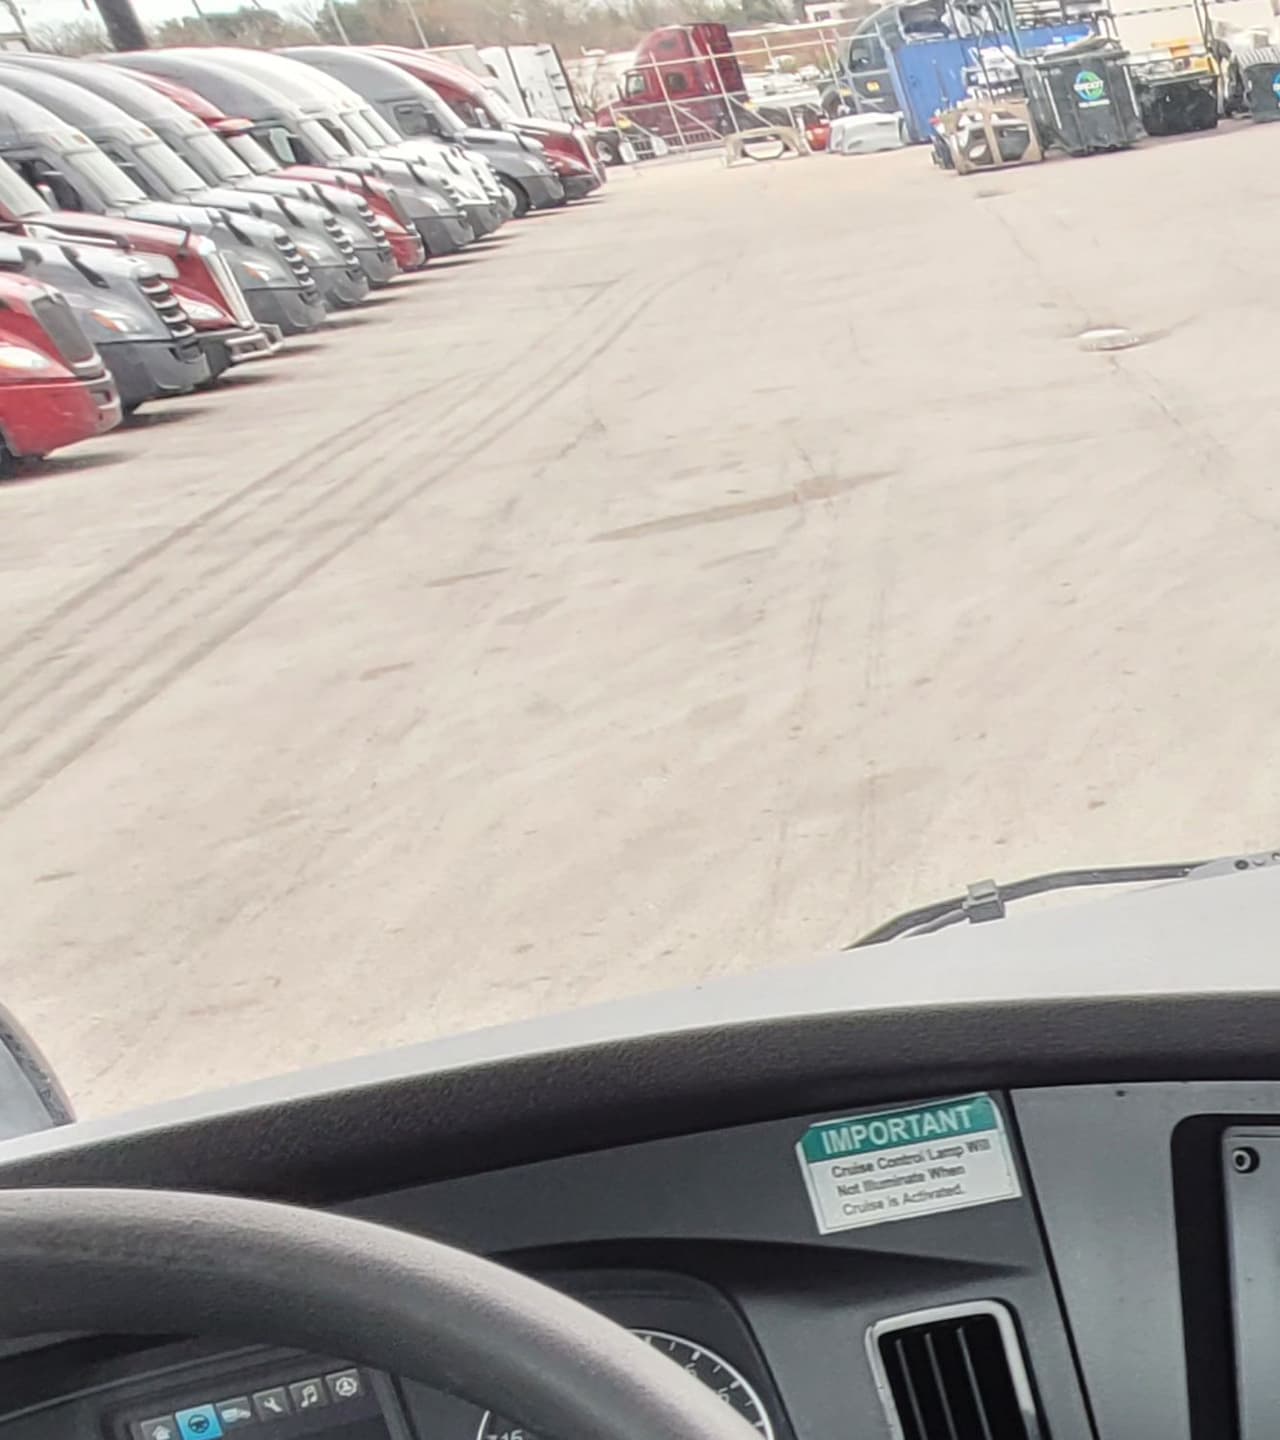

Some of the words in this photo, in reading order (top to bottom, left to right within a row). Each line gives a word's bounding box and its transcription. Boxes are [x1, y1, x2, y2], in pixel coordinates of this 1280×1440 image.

[821, 1106, 974, 1154] IMPORTANT
[831, 1158, 874, 1178] Cruise
[877, 1151, 925, 1170] Control
[929, 1144, 963, 1161] Lamp
[967, 1139, 991, 1153] Will
[837, 1183, 861, 1197] Not
[864, 1172, 925, 1191] Illuminate
[930, 1165, 966, 1179] When
[842, 1199, 883, 1215] Cruise
[888, 1193, 899, 1207] is
